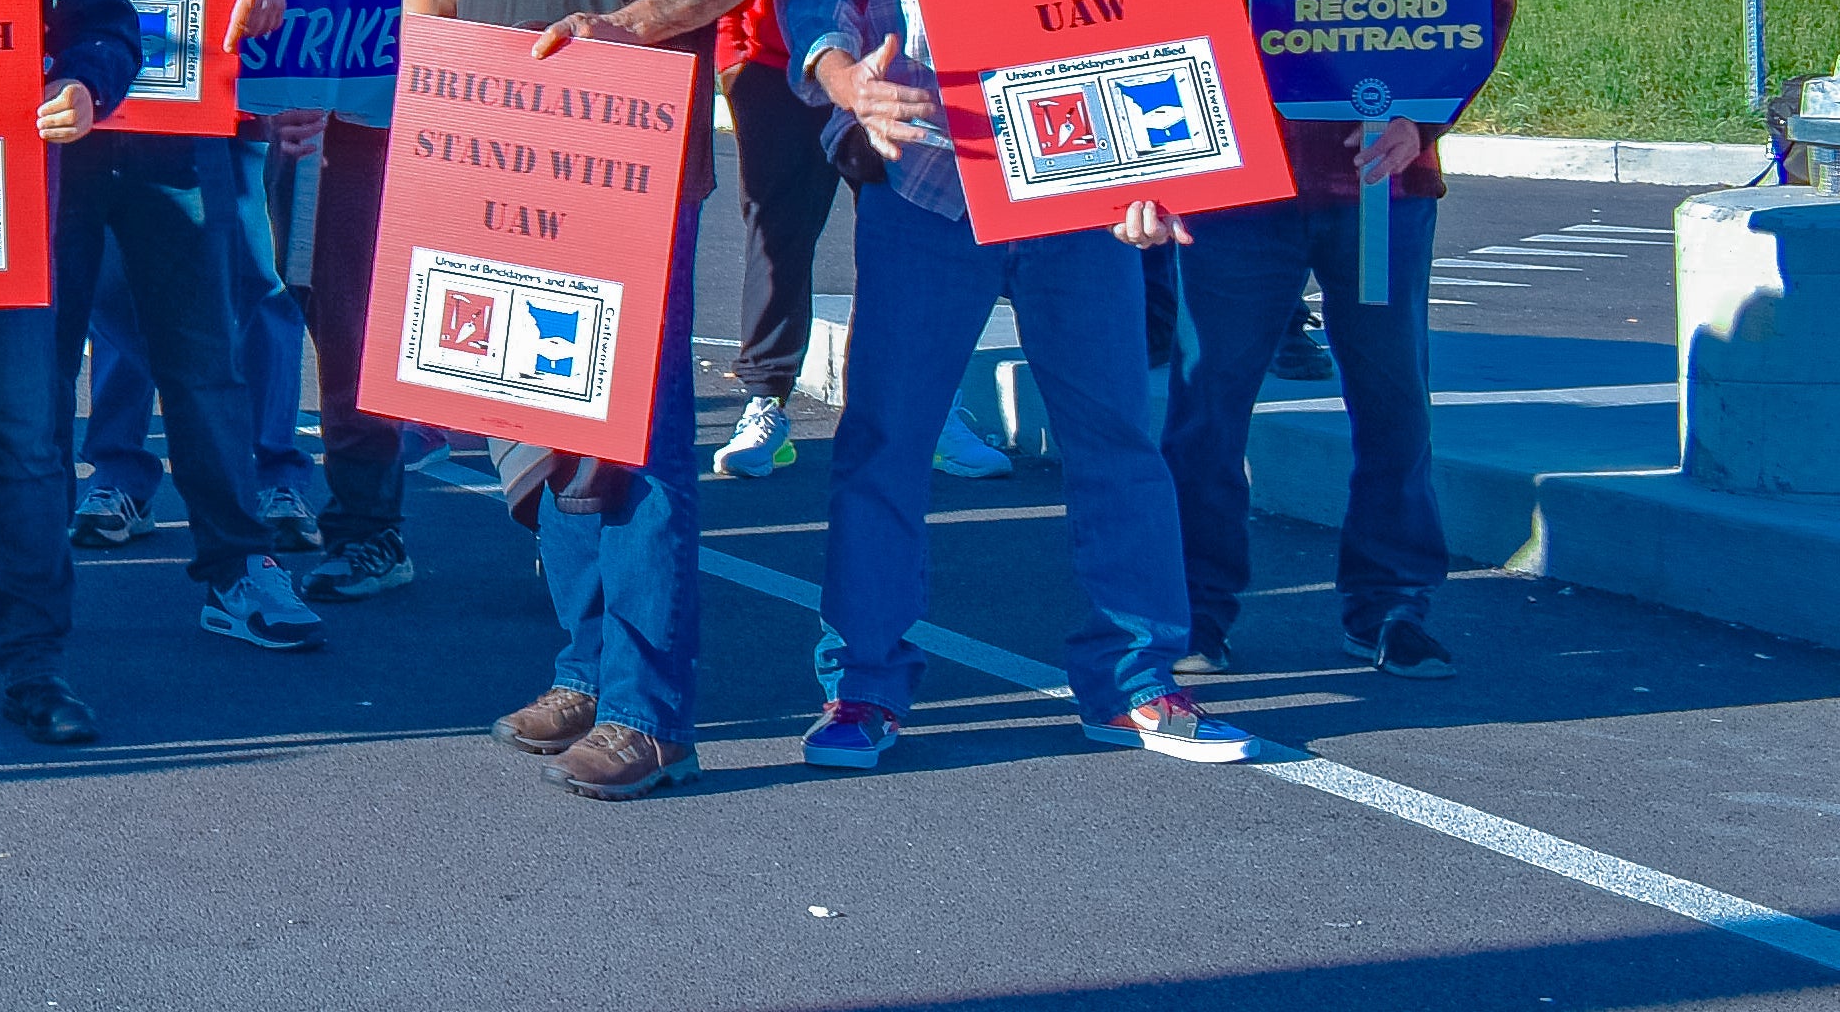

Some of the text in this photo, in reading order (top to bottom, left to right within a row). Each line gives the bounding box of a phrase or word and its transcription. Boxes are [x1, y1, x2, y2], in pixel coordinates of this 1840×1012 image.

[240, 6, 401, 70] STRIKE
[1006, 45, 1186, 82] Union of Bricklayers and Allied
[1260, 23, 1484, 55] CONTRACTS
[409, 64, 676, 133] BRICKLAYERS
[1200, 60, 1230, 149] Craftworkers
[414, 129, 652, 194] STAND WITH
[990, 94, 1020, 178] International
[483, 200, 567, 240] UAW
